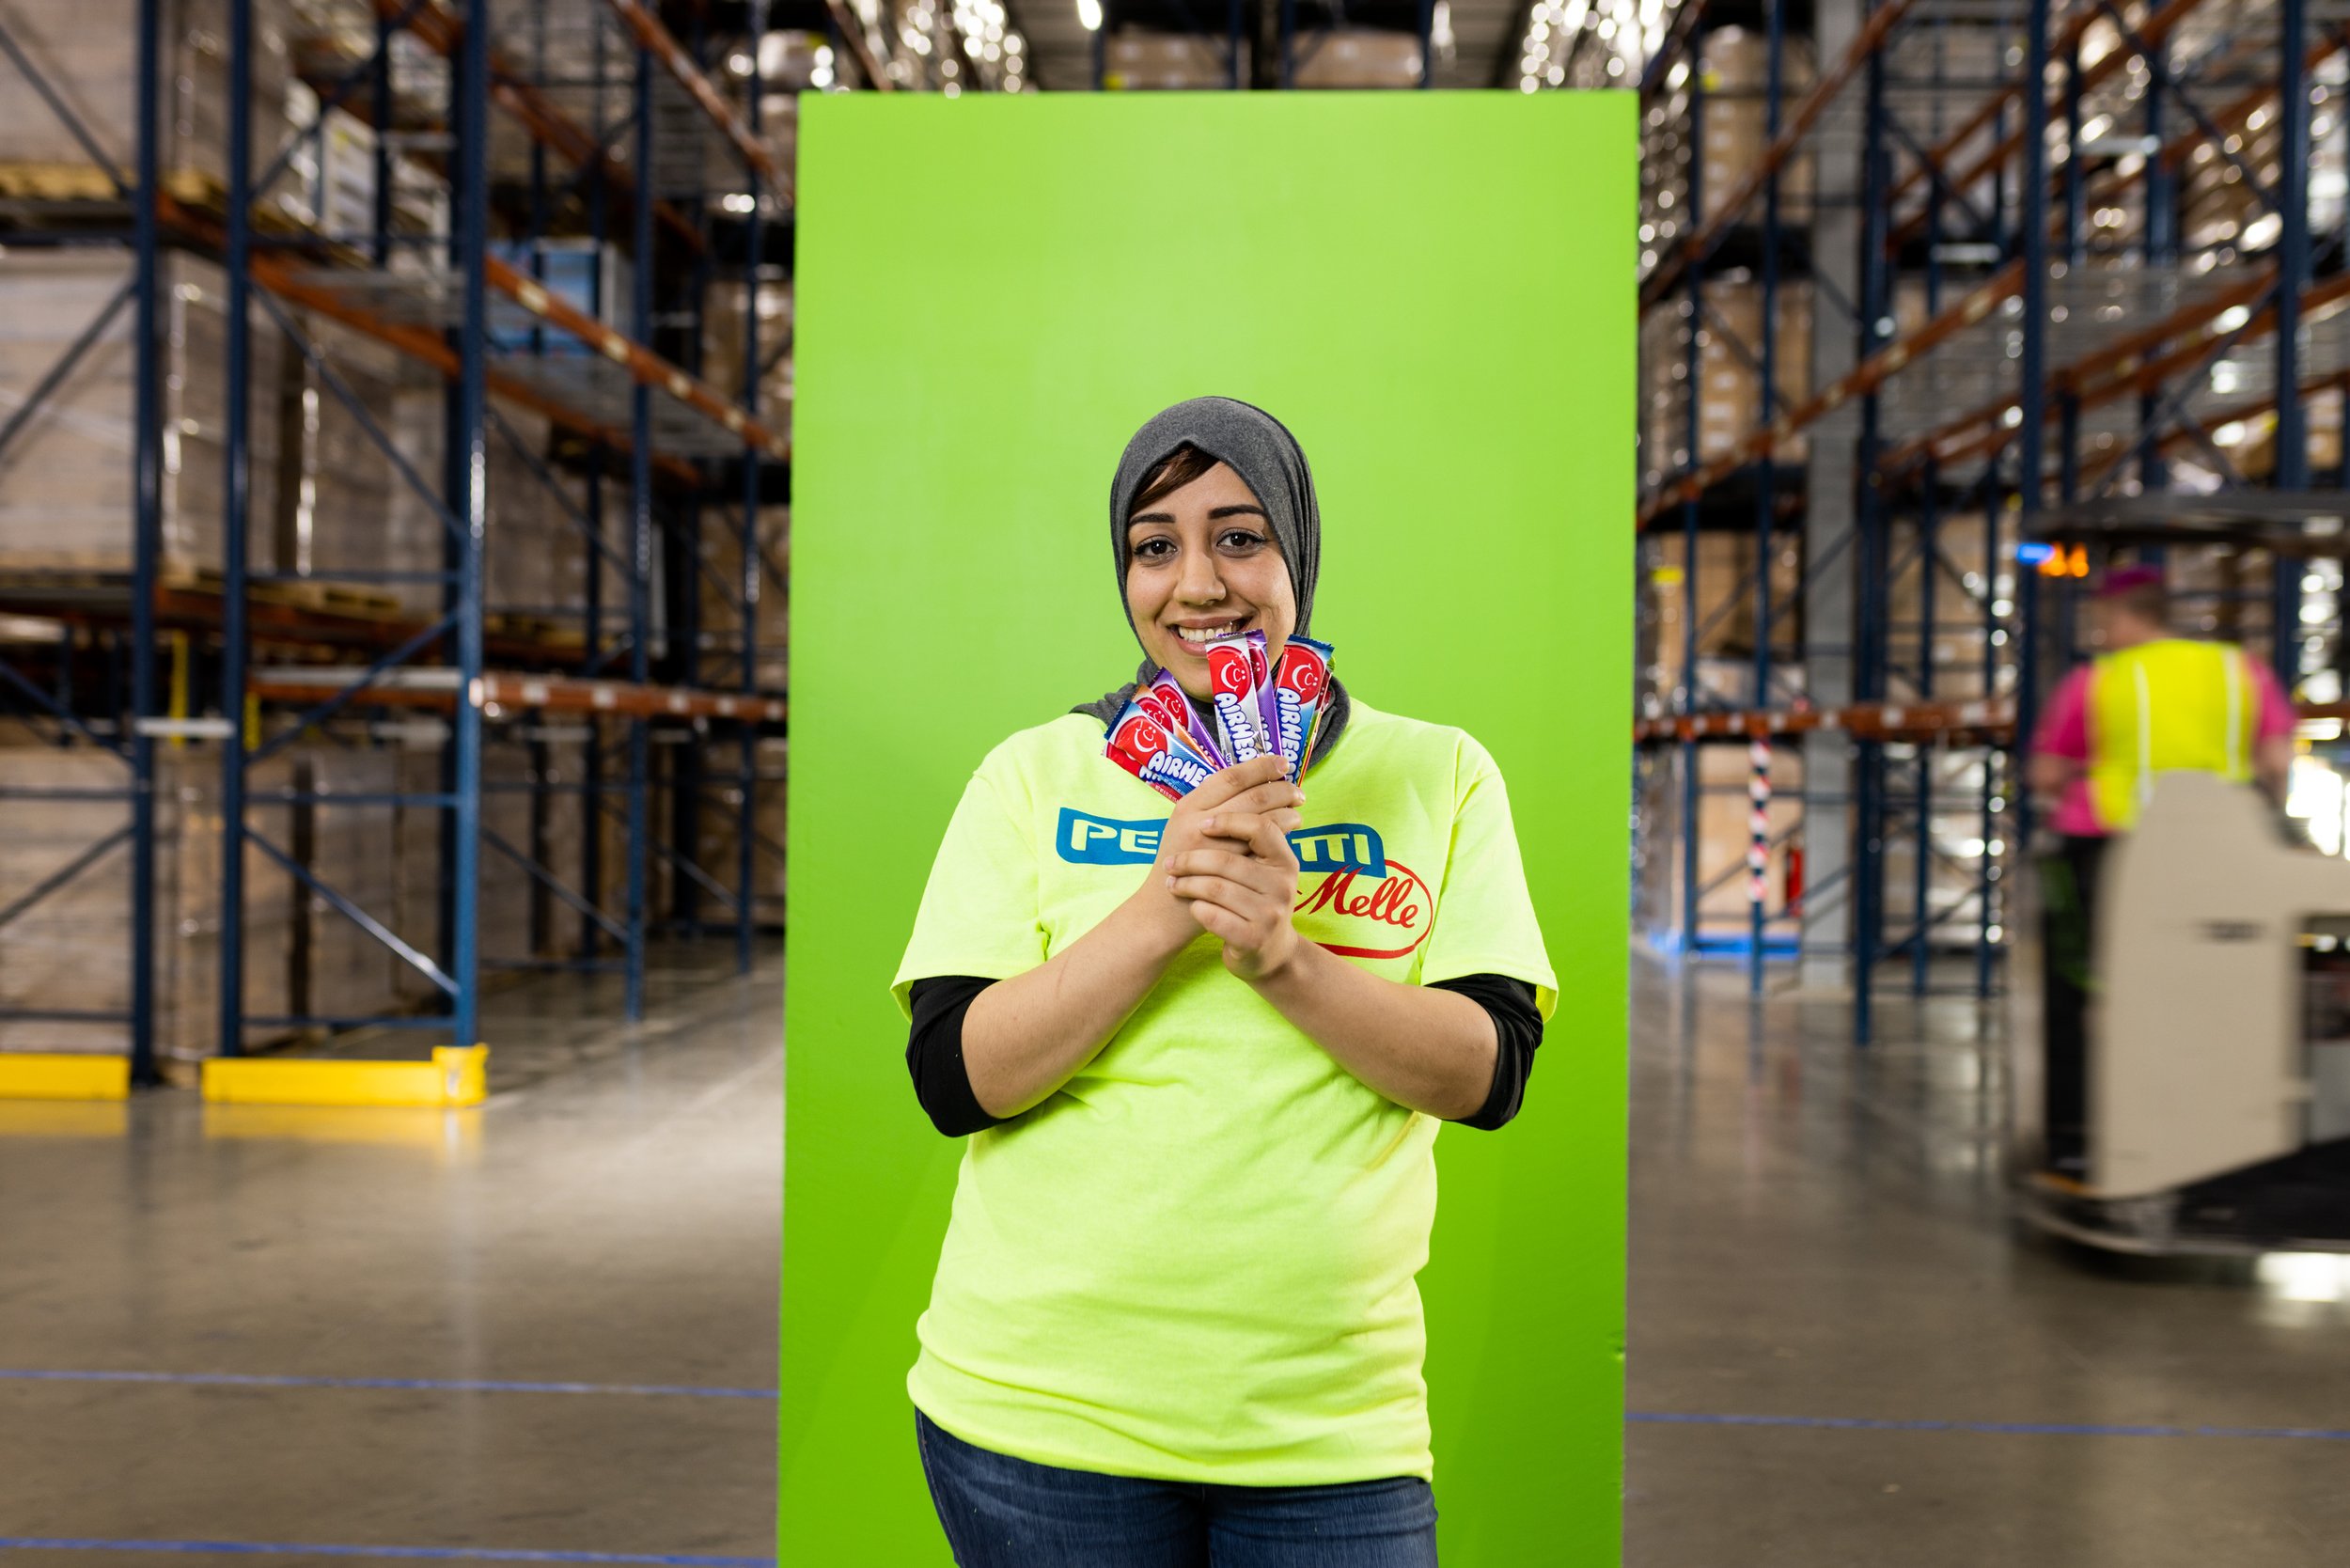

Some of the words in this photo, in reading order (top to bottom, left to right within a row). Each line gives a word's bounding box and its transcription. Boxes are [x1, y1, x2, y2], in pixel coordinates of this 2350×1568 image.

[1214, 692, 1258, 762] AIRHEA
[1147, 750, 1214, 788] AIRHE
[1071, 819, 1371, 865] PETTI
[1293, 864, 1418, 929] Melle
